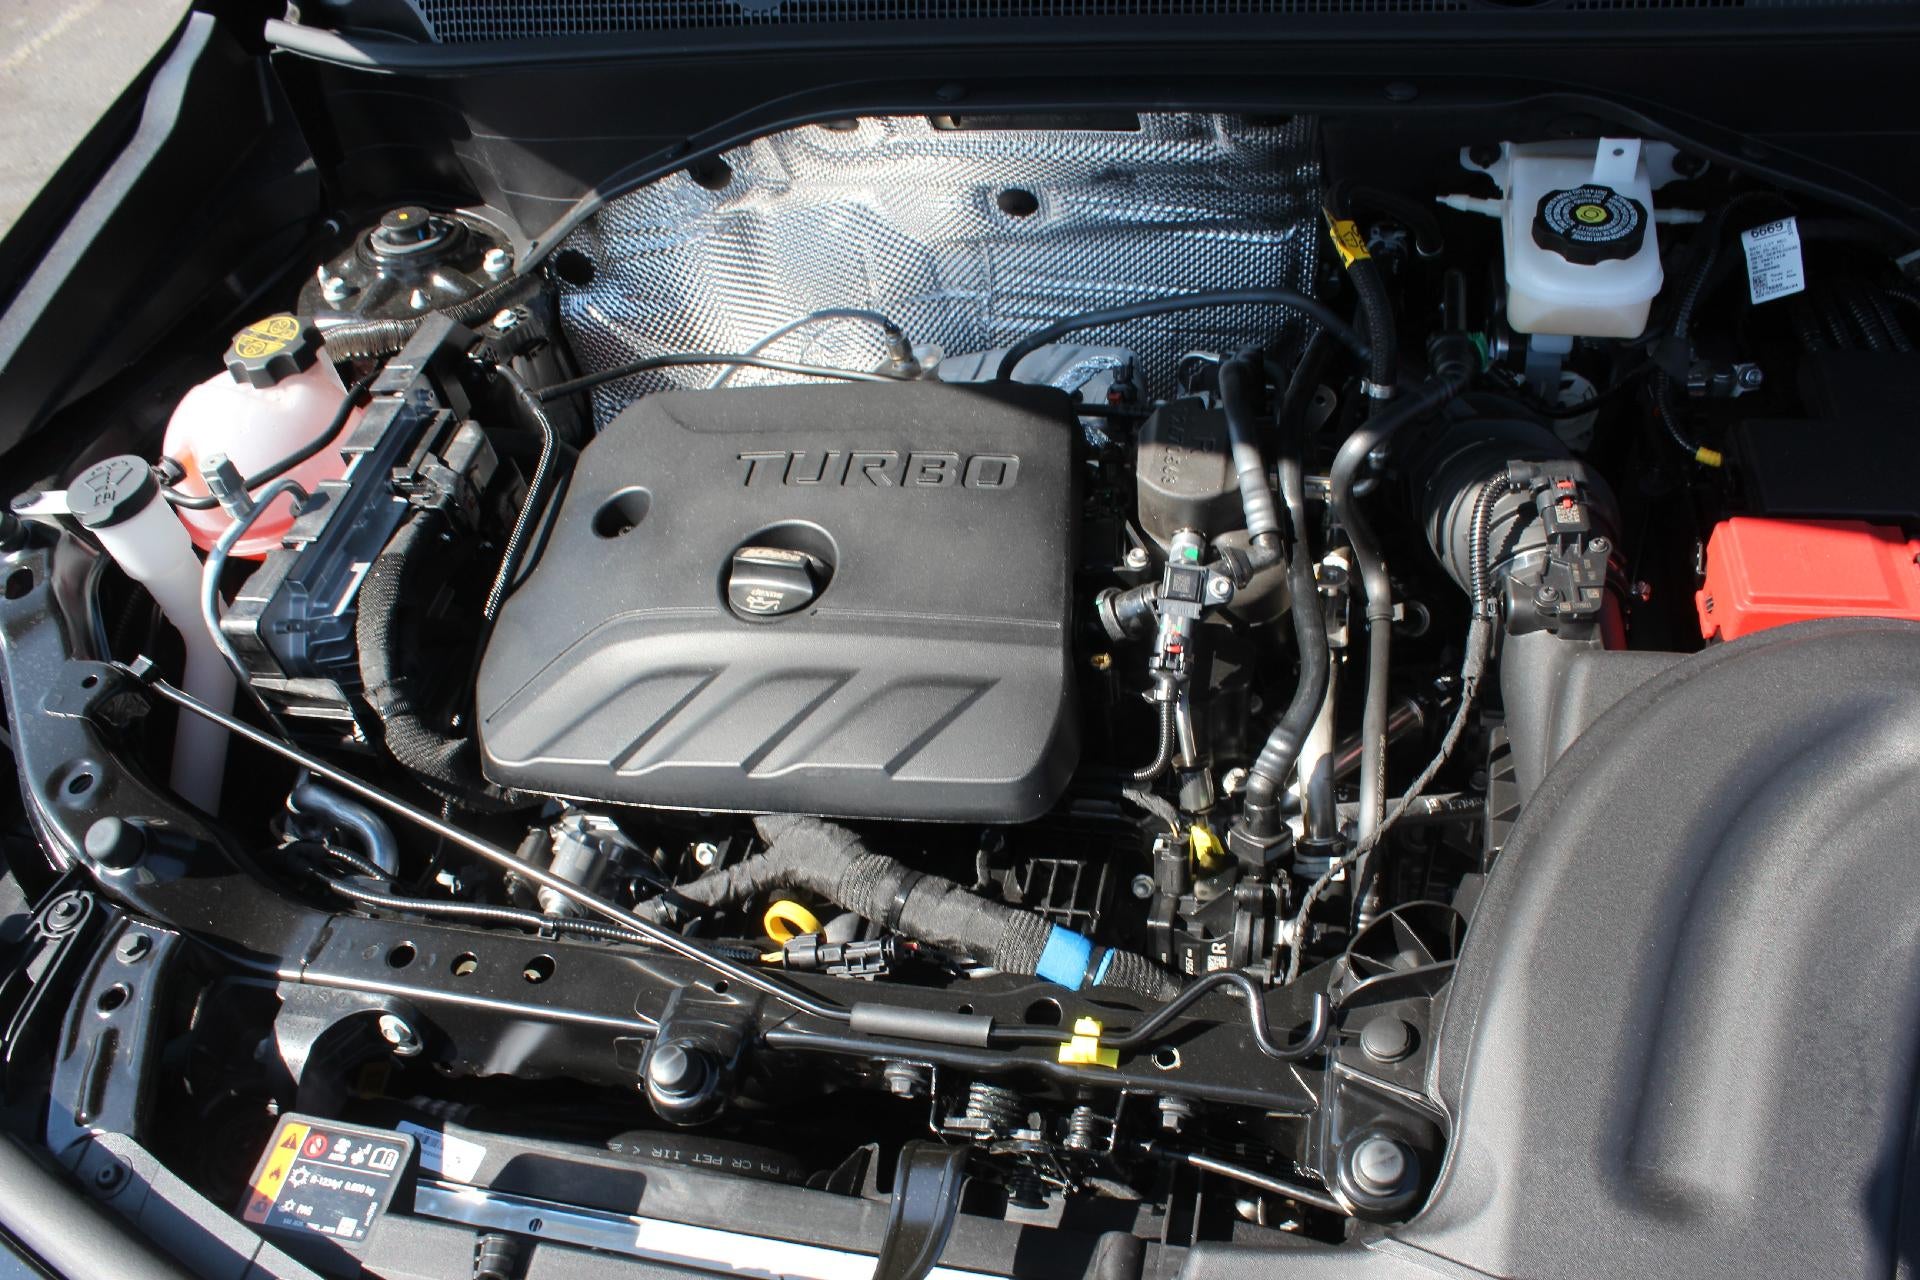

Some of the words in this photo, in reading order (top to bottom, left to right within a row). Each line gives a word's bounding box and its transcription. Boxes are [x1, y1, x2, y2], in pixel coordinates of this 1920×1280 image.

[736, 449, 1021, 490] TURBO
[1211, 942, 1227, 955] R
[651, 1147, 681, 1160] IIR
[692, 1153, 723, 1166] PET
[731, 1159, 752, 1170] CR
